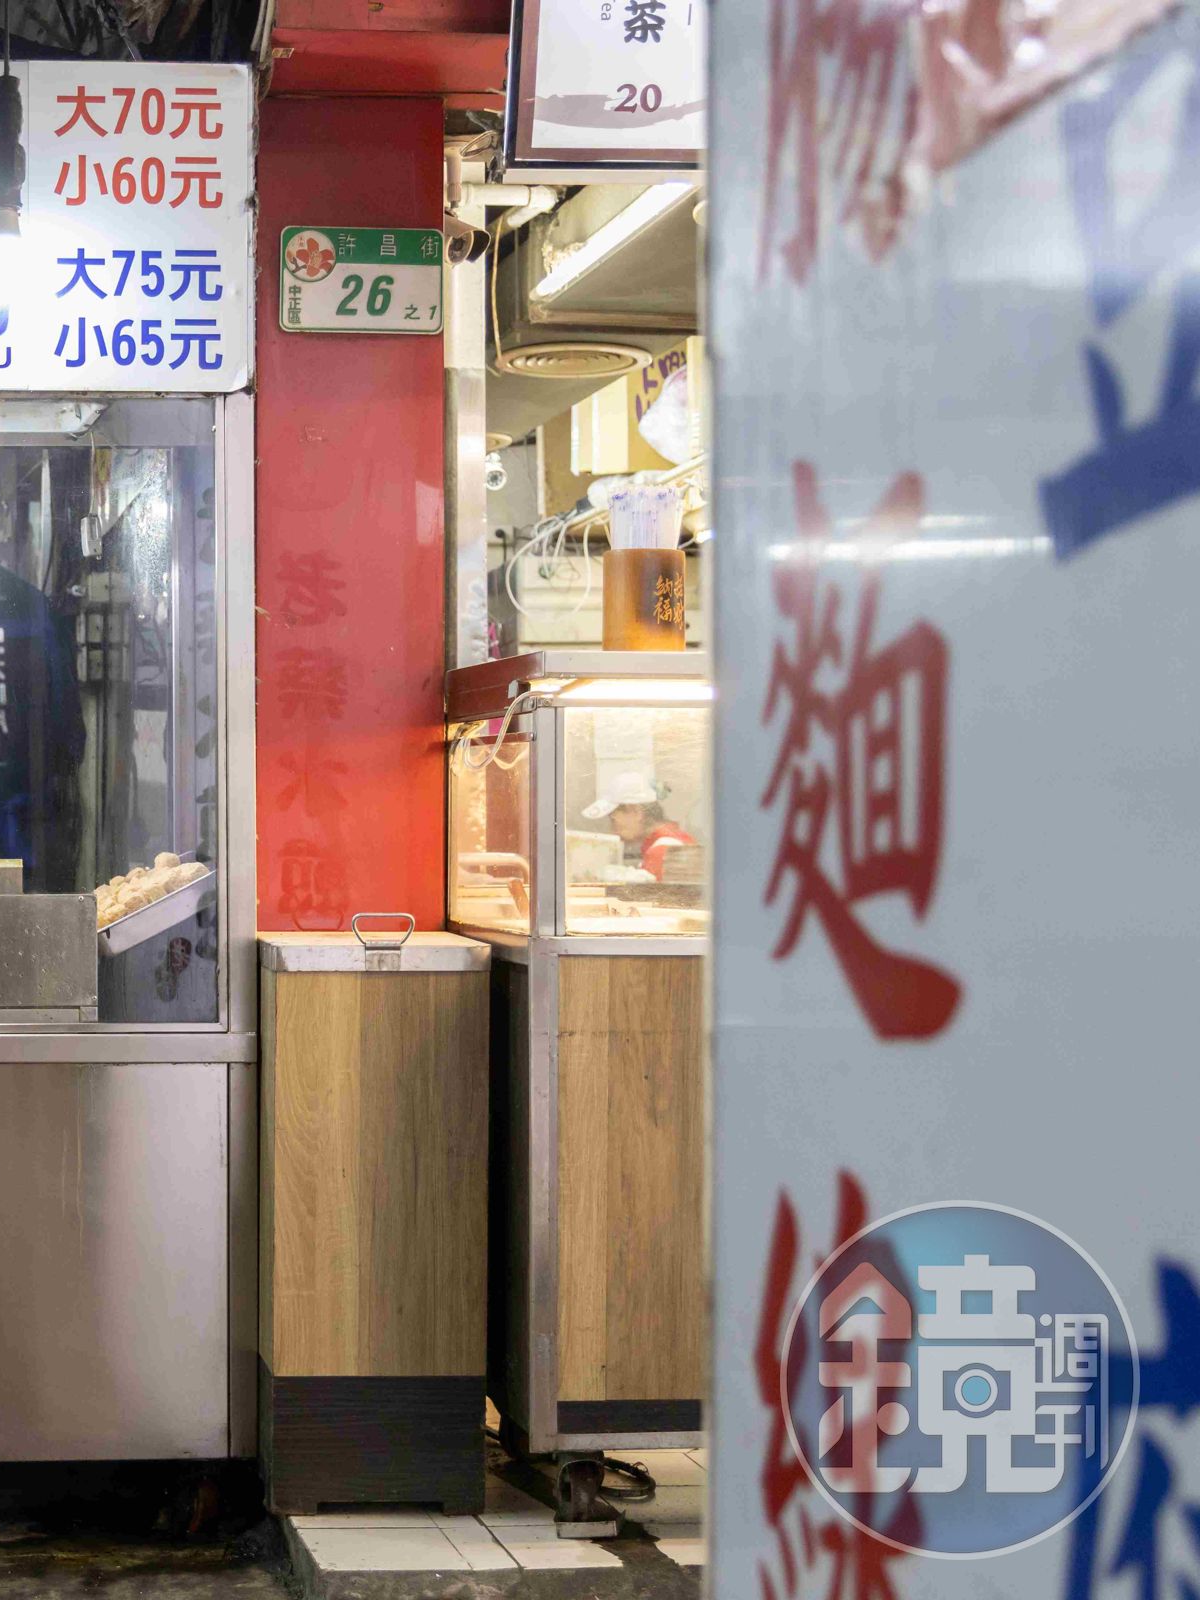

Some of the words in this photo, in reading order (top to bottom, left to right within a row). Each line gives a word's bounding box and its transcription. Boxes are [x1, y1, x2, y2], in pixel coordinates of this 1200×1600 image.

[623, 0, 667, 43] 茶
[54, 86, 224, 140] 大70元
[614, 84, 663, 113] 20
[53, 154, 224, 209] 小60元
[338, 233, 440, 259] 許昌街
[54, 248, 224, 302] 大75元
[336, 273, 395, 317] 26
[288, 285, 302, 324] 中正區
[403, 303, 438, 321] 之1
[53, 317, 224, 371] 小65元
